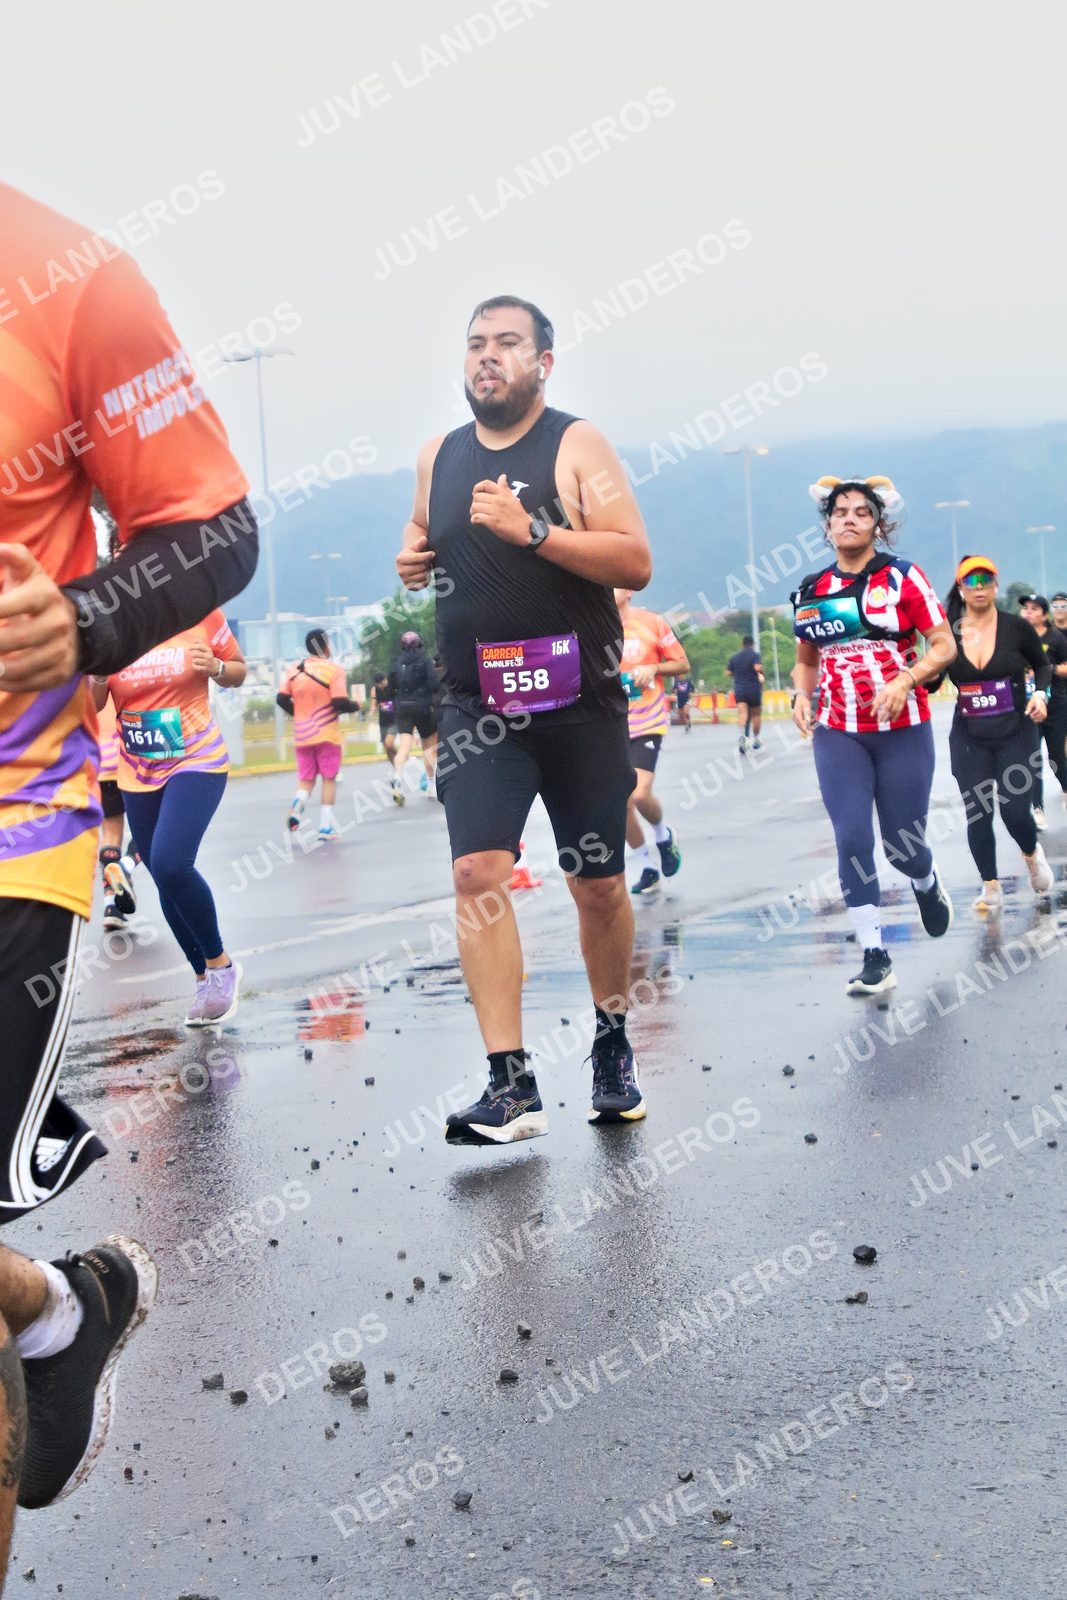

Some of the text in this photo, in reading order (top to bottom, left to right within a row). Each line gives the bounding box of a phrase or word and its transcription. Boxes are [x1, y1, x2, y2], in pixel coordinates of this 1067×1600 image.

[805, 619, 846, 639] 1430
[482, 646, 524, 660] CARRERA
[483, 658, 515, 668] OMNILIFE
[502, 668, 550, 693] 558
[971, 694, 997, 708] 599
[127, 728, 165, 746] 1614
